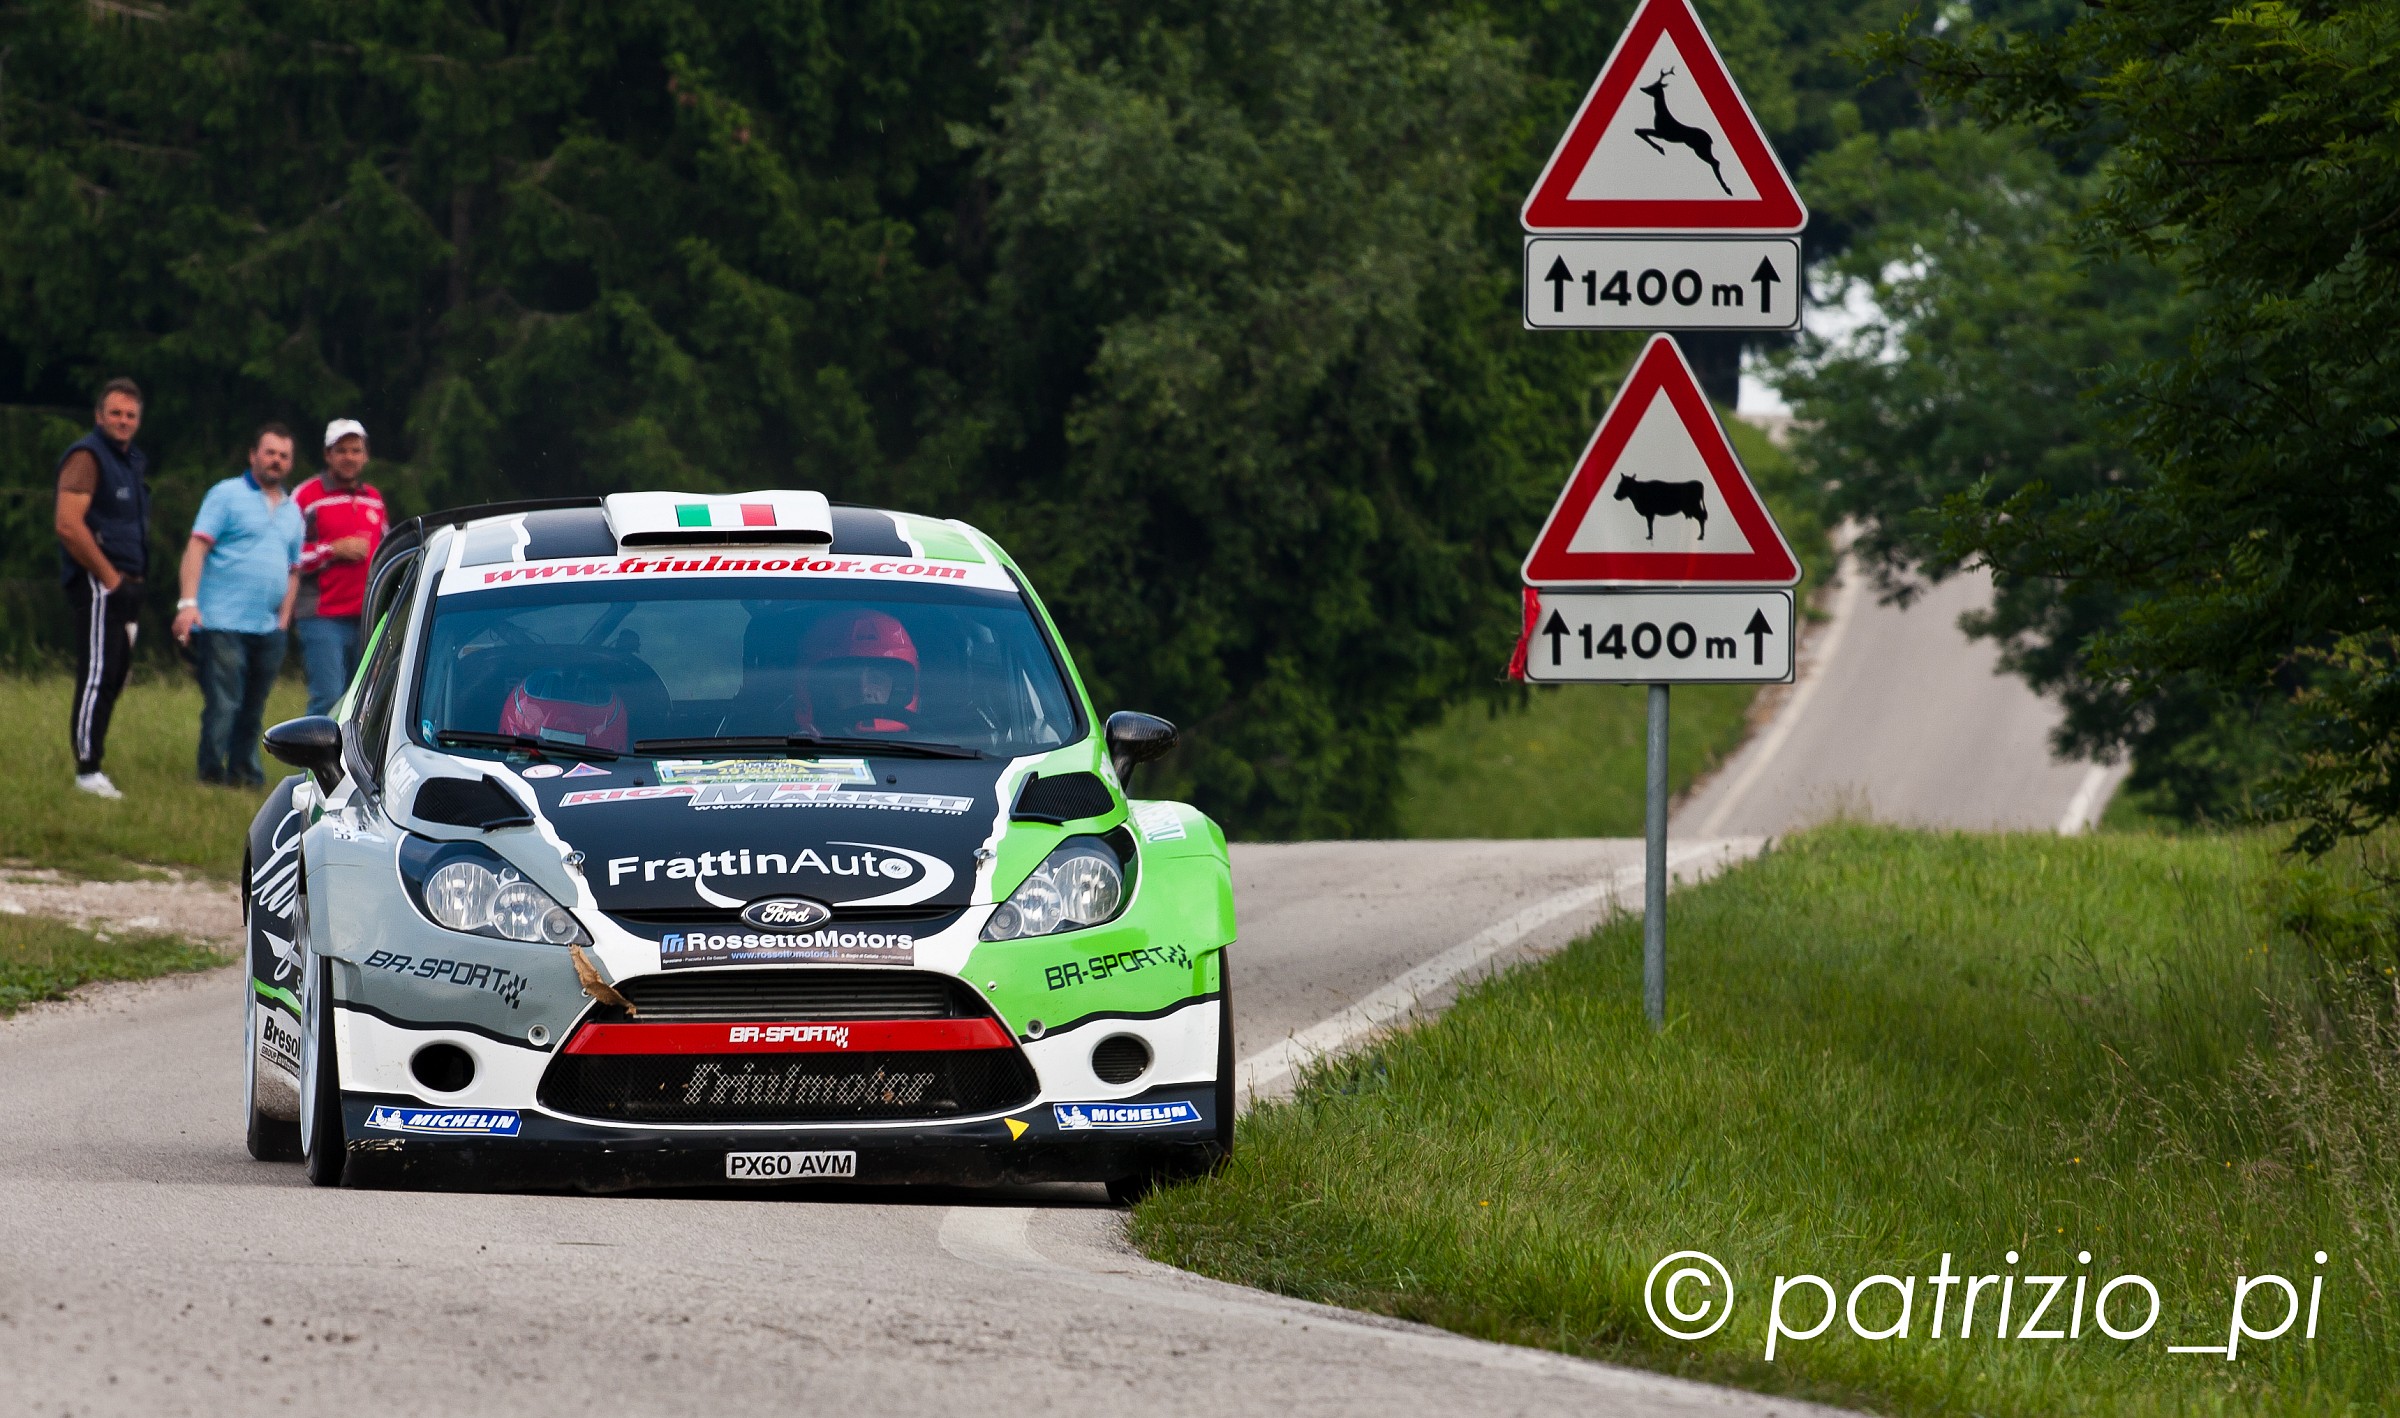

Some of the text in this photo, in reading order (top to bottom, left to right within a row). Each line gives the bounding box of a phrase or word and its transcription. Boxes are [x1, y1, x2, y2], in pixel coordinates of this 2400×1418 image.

[1582, 268, 1744, 307] 1400 m
[483, 555, 967, 584] www.friulmotor.com
[1578, 622, 1737, 659] 1400 m
[609, 848, 913, 887] FrattinAuto
[760, 904, 810, 924] Ford
[687, 930, 913, 952] RossettoMotors
[365, 949, 511, 991] BR-SPORT
[1045, 946, 1167, 992] BR-SPORT
[730, 1026, 837, 1043] BR-SPORT
[408, 1113, 518, 1132] MICHELIN
[1091, 1105, 1187, 1122] MICHELIN
[731, 1156, 852, 1175] PX60 AVM
